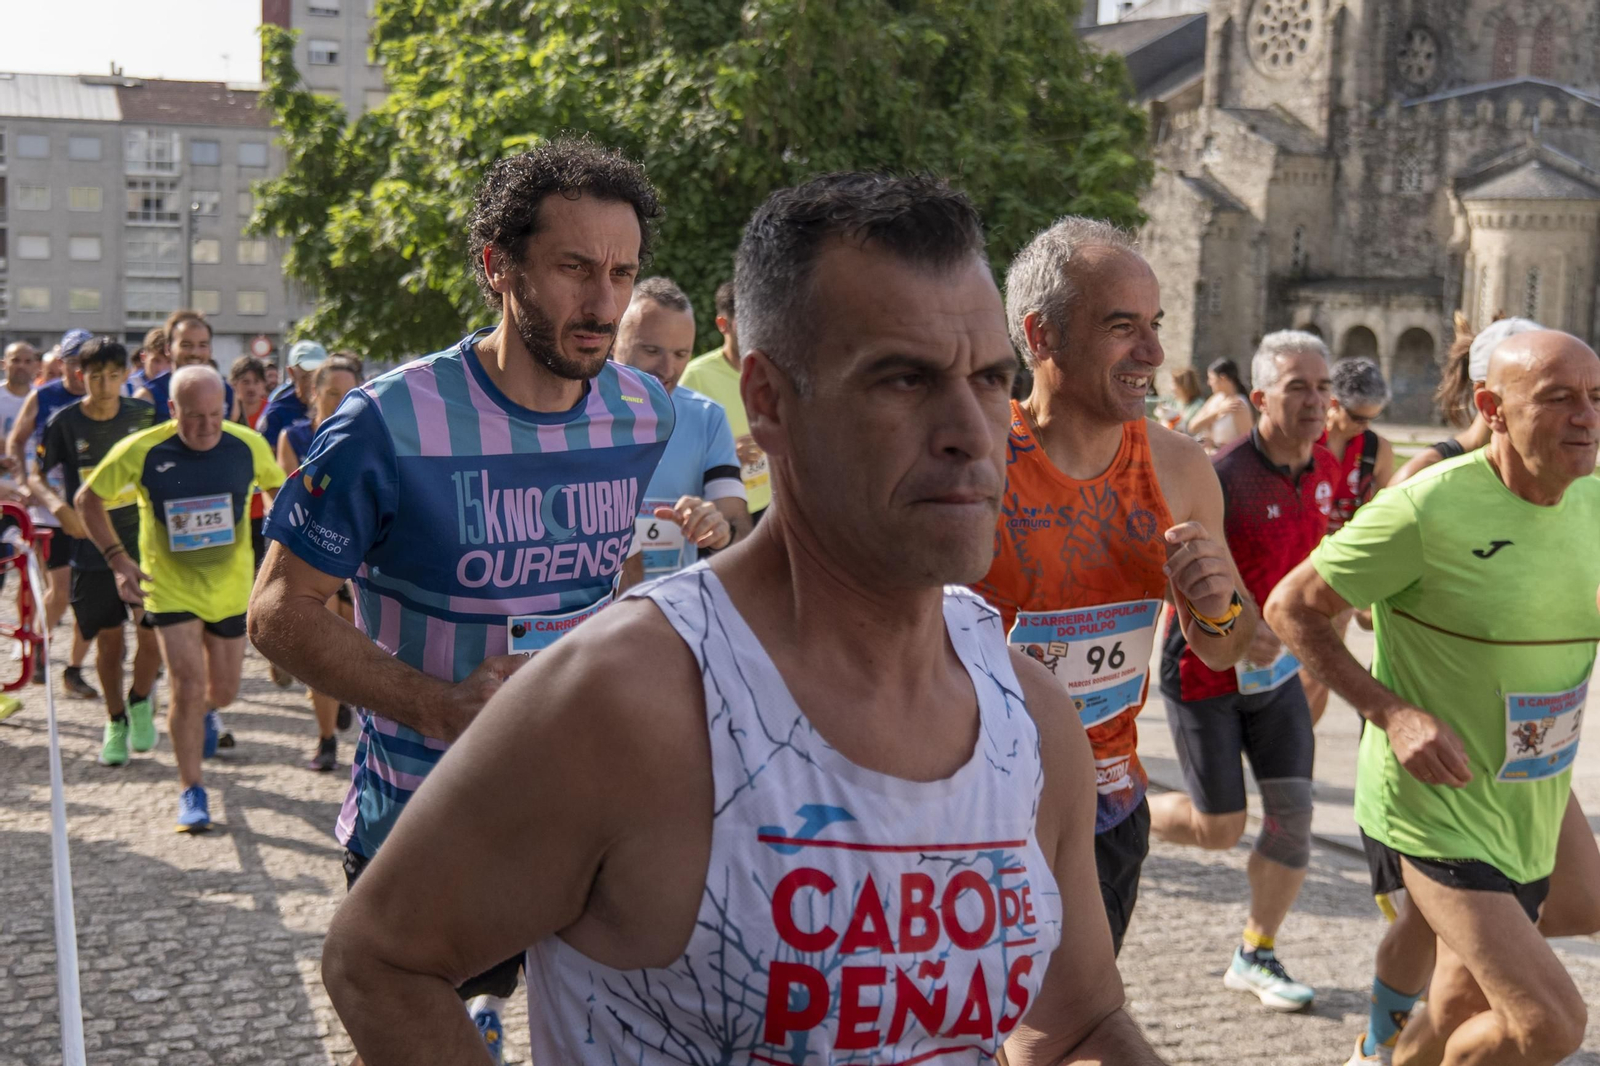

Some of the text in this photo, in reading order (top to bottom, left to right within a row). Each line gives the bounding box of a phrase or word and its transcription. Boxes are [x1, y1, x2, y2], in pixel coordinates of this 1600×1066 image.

[195, 512, 222, 527] 125
[1010, 518, 1051, 529] amura
[307, 530, 342, 554] GALEGO
[311, 520, 350, 546] DEPORTE
[647, 523, 659, 540] 6
[456, 532, 632, 588] OURENSE
[535, 611, 594, 632] CARREIRA
[1031, 613, 1094, 627] CARREIRA
[1097, 604, 1148, 621] POPULAR
[1057, 620, 1116, 637] DO PULPO
[1086, 641, 1126, 675] 96
[1068, 679, 1091, 689] MARCOS
[771, 867, 1037, 955] CABO DE
[764, 954, 1034, 1050] PEÑAS
